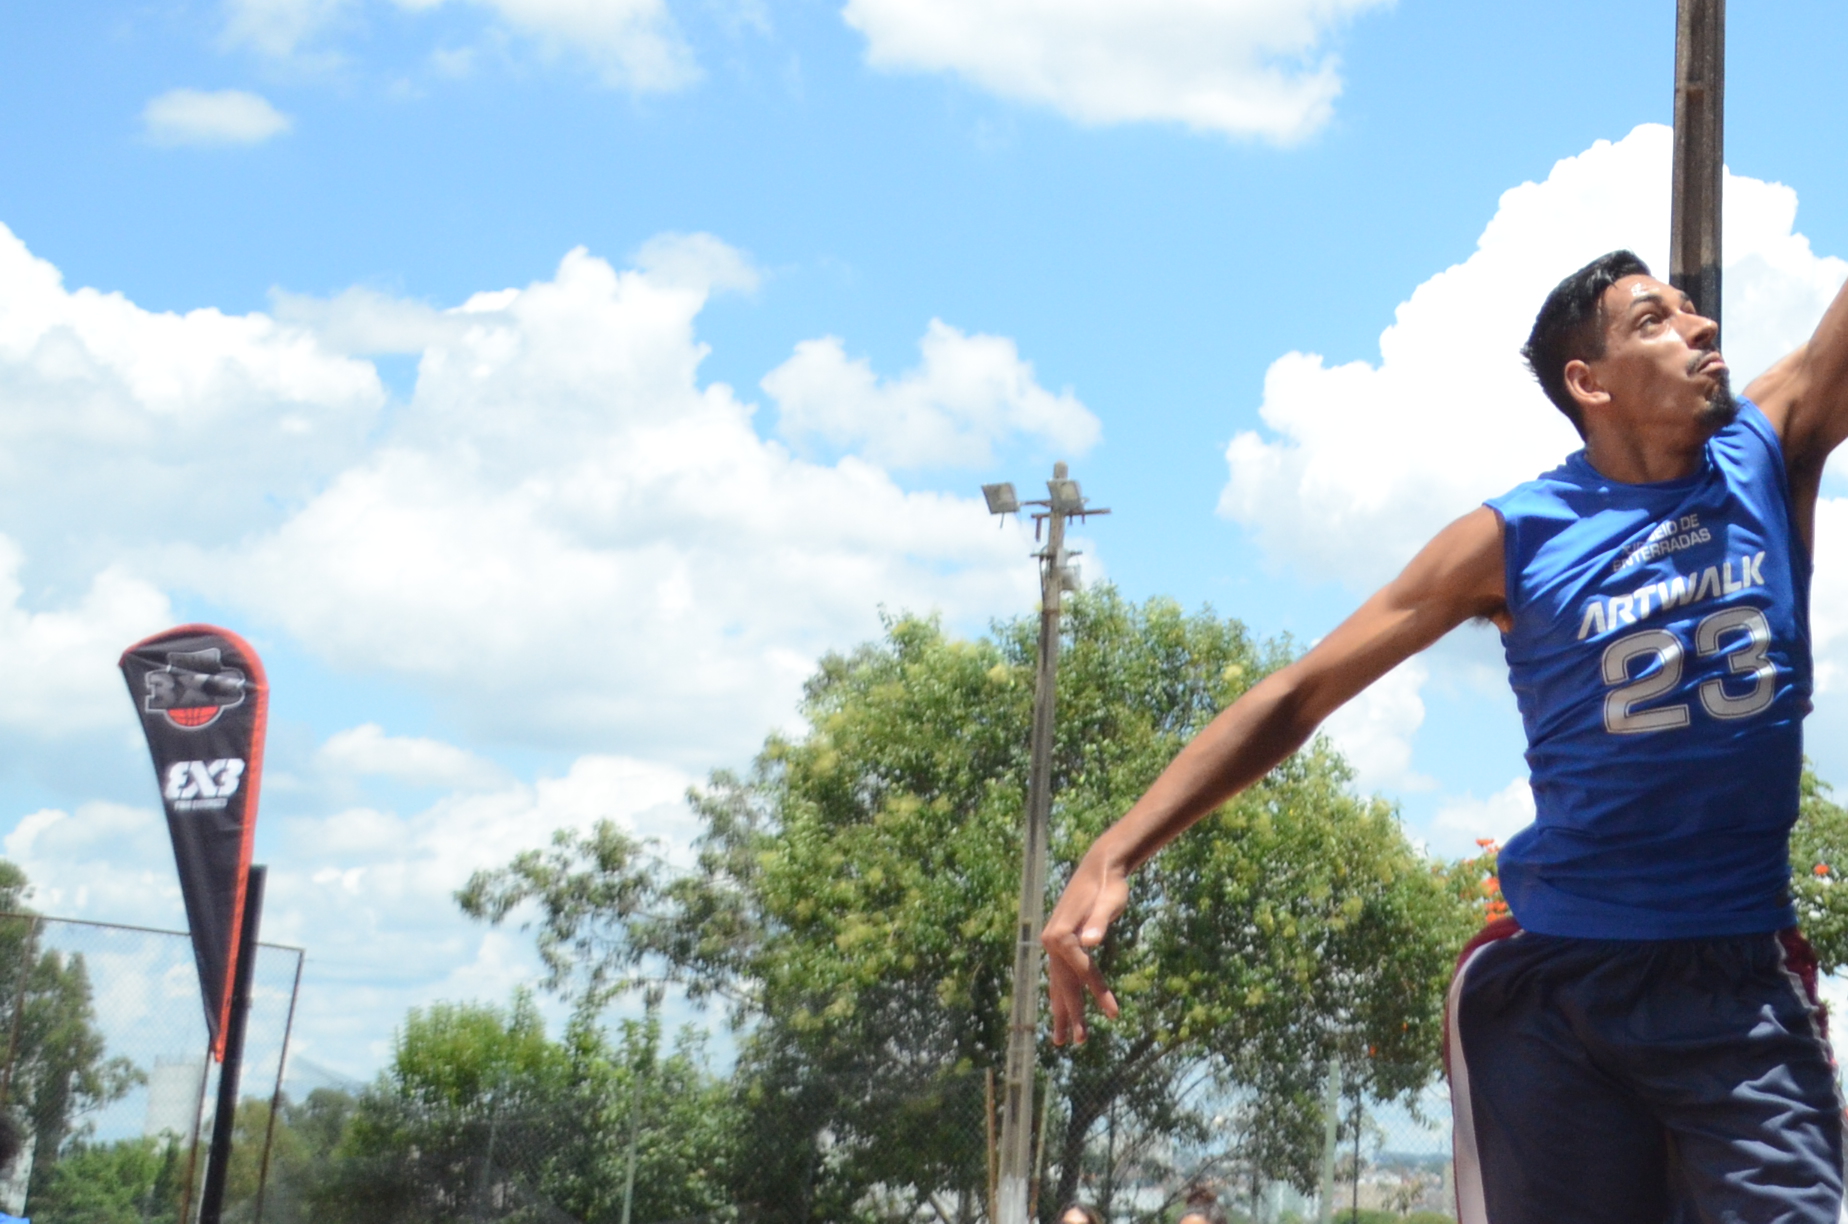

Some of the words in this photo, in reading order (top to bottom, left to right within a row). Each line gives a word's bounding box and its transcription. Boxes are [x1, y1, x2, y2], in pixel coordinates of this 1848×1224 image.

[1612, 527, 1712, 572] ENTERRADAS
[1680, 514, 1700, 531] DE
[1576, 551, 1765, 640] ARTWALK
[1602, 605, 1777, 734] 23
